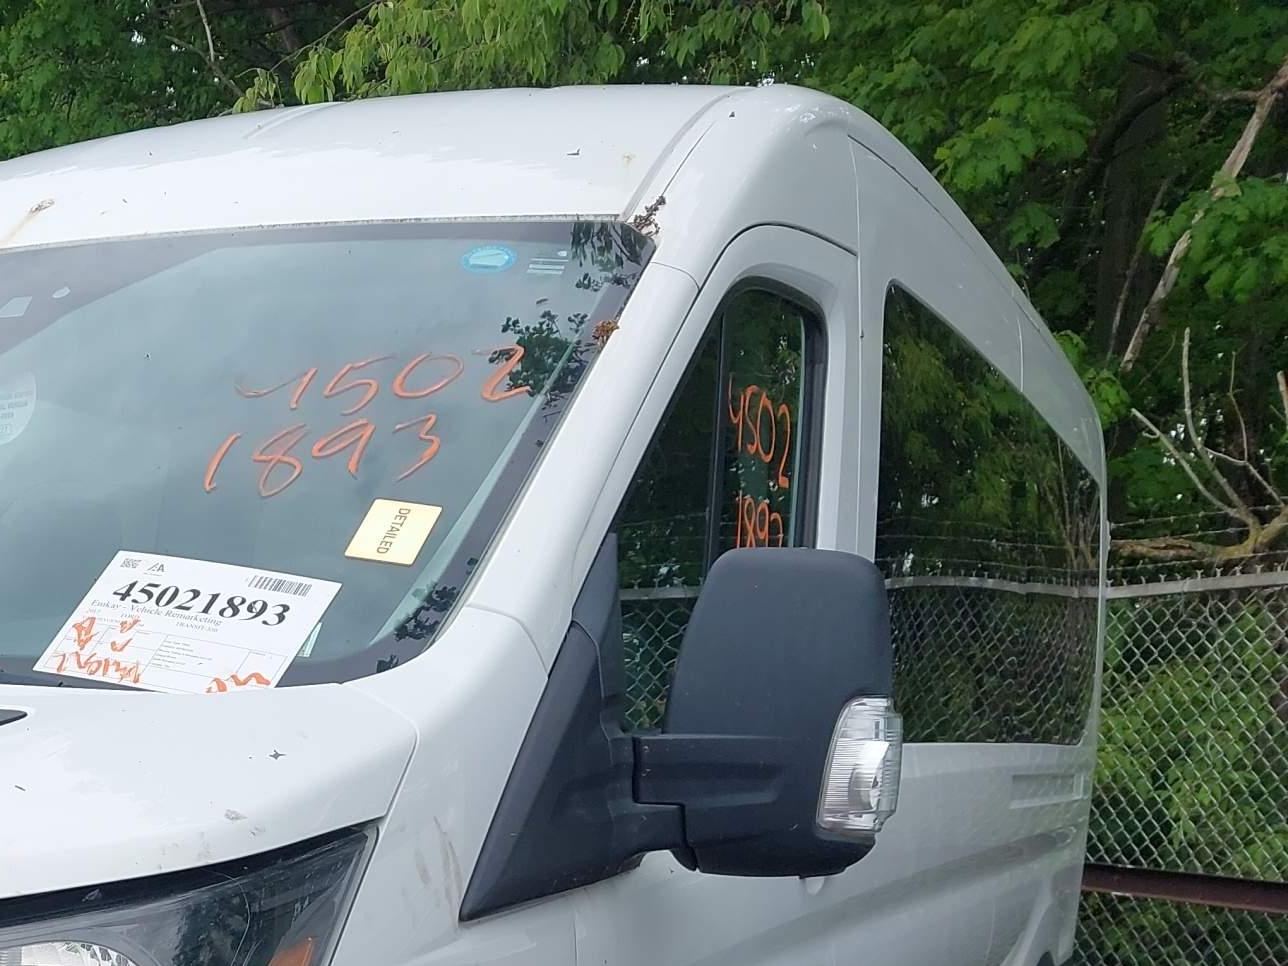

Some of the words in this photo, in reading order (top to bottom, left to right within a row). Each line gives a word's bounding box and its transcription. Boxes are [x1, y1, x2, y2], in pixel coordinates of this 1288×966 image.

[728, 372, 791, 488] 4502
[203, 414, 441, 497] 1893
[376, 507, 411, 554] DETAILED
[113, 580, 290, 626] 45021893
[130, 604, 163, 616] Vehicle
[165, 609, 222, 626] Remarketing
